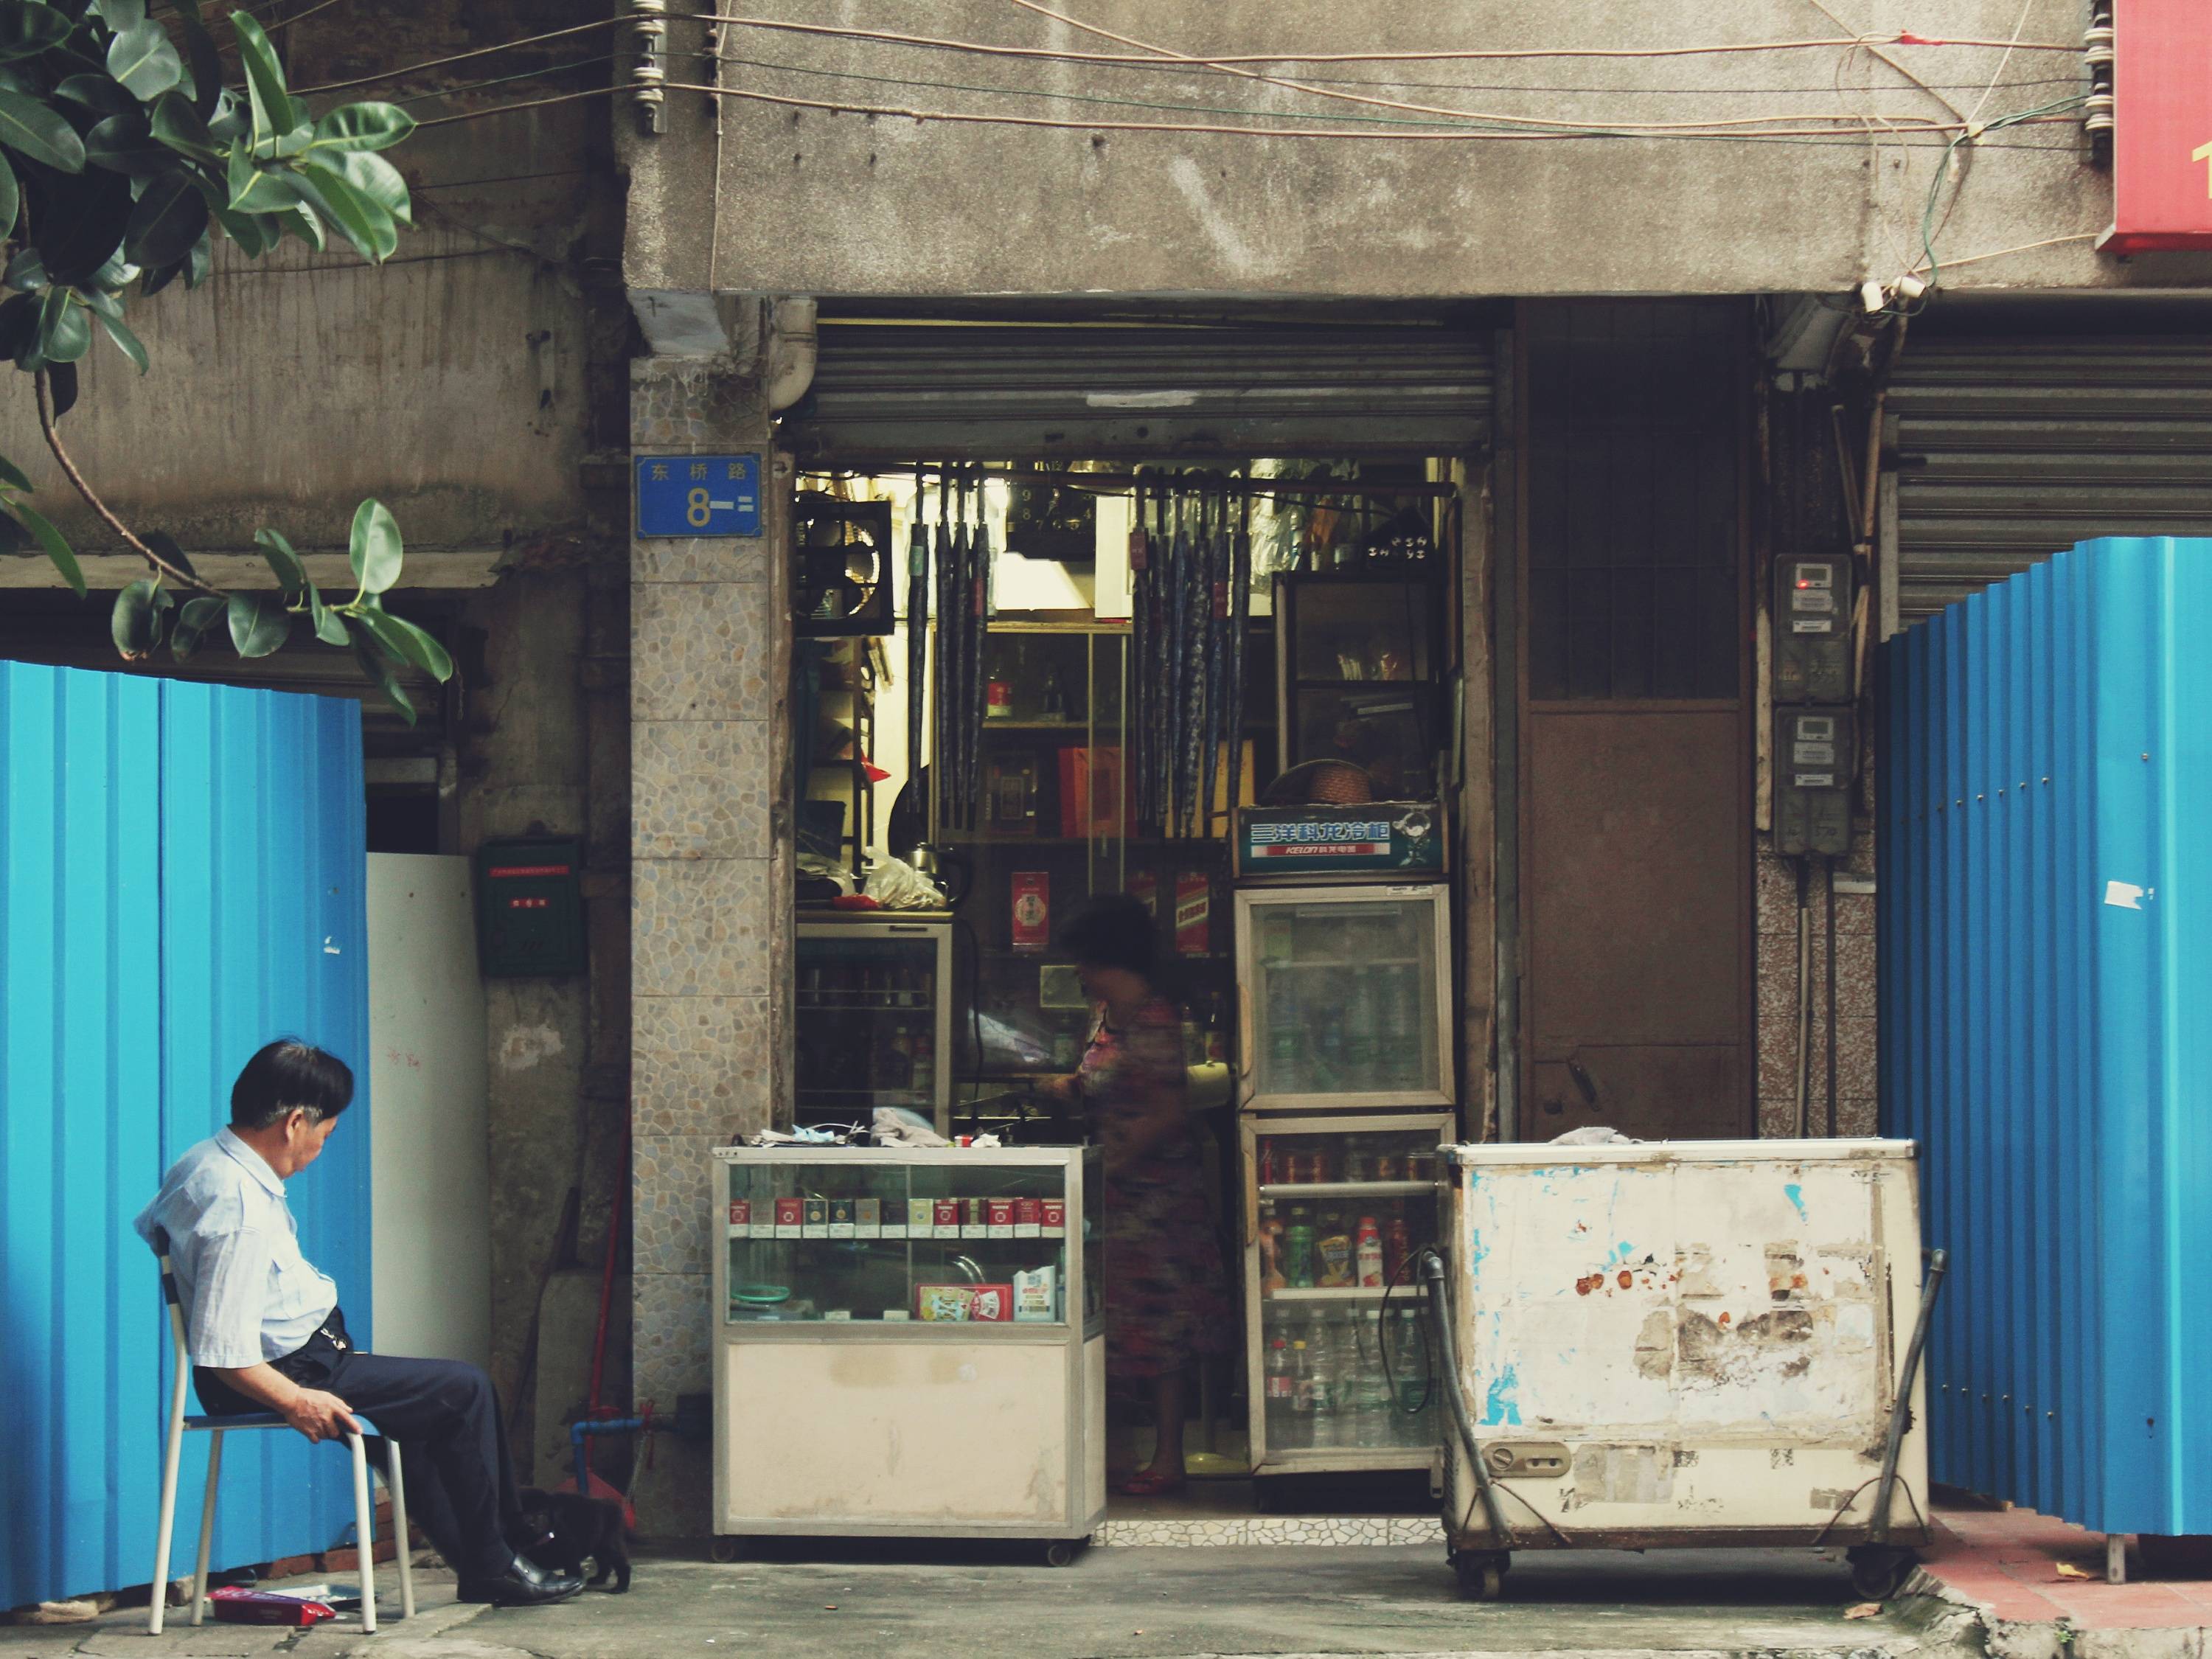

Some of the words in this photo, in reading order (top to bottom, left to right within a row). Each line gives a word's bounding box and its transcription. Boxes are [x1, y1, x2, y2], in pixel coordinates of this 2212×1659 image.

[1022, 490, 1032, 501] 9
[1023, 508, 1031, 520] 8
[1251, 821, 1390, 843] 三洋科龙冷柜
